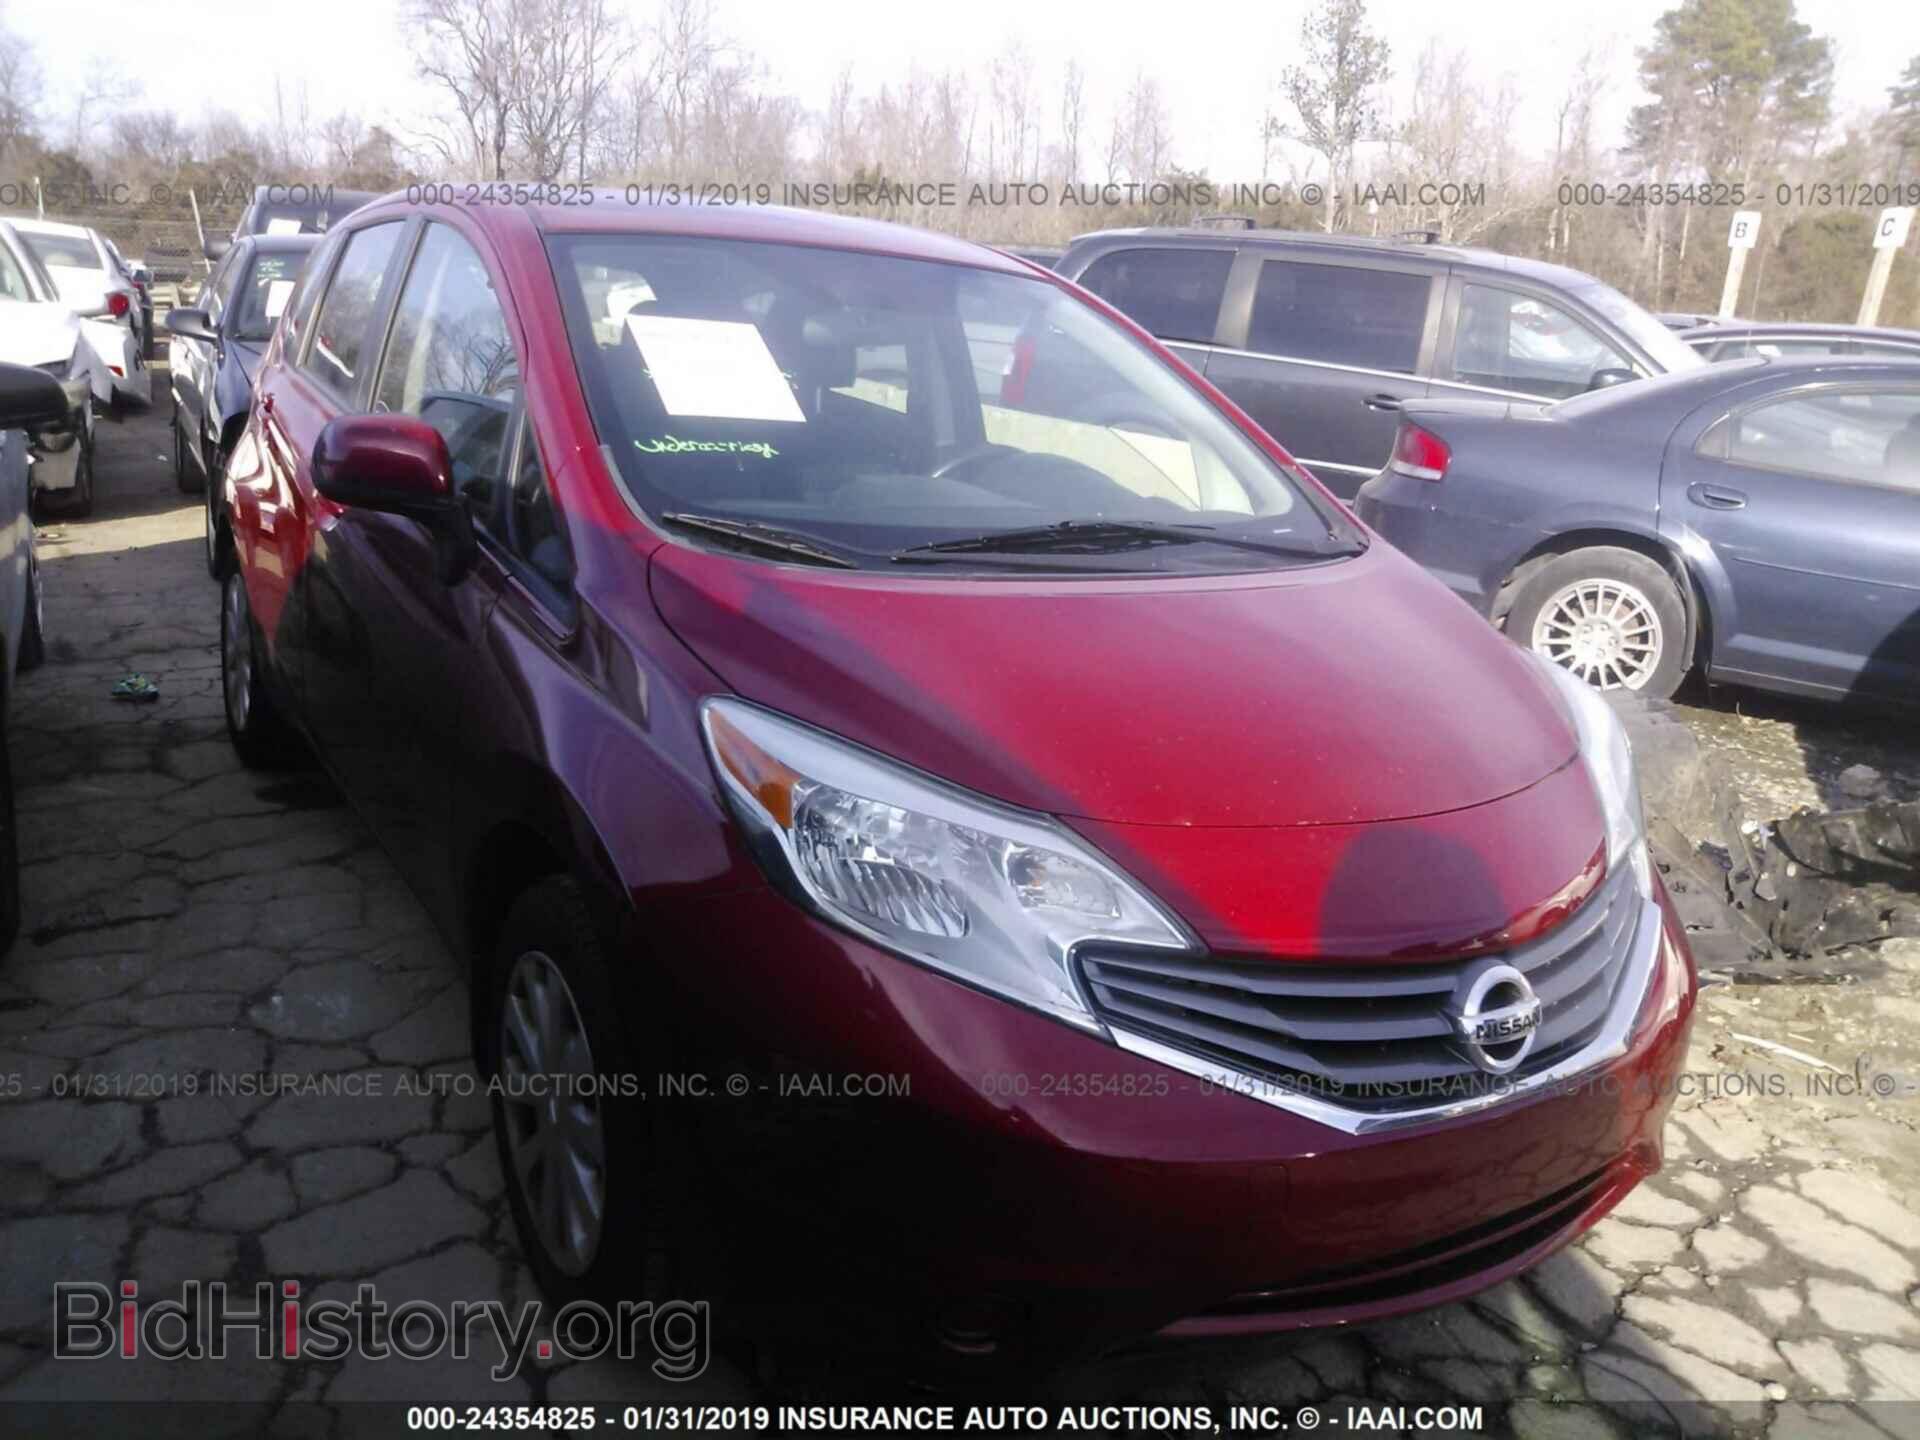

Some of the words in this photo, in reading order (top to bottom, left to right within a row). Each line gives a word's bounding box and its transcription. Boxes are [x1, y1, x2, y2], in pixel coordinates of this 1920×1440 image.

[1735, 221, 1748, 238] B
[1881, 217, 1895, 236] C
[1475, 1010, 1541, 1039] NISSAN
